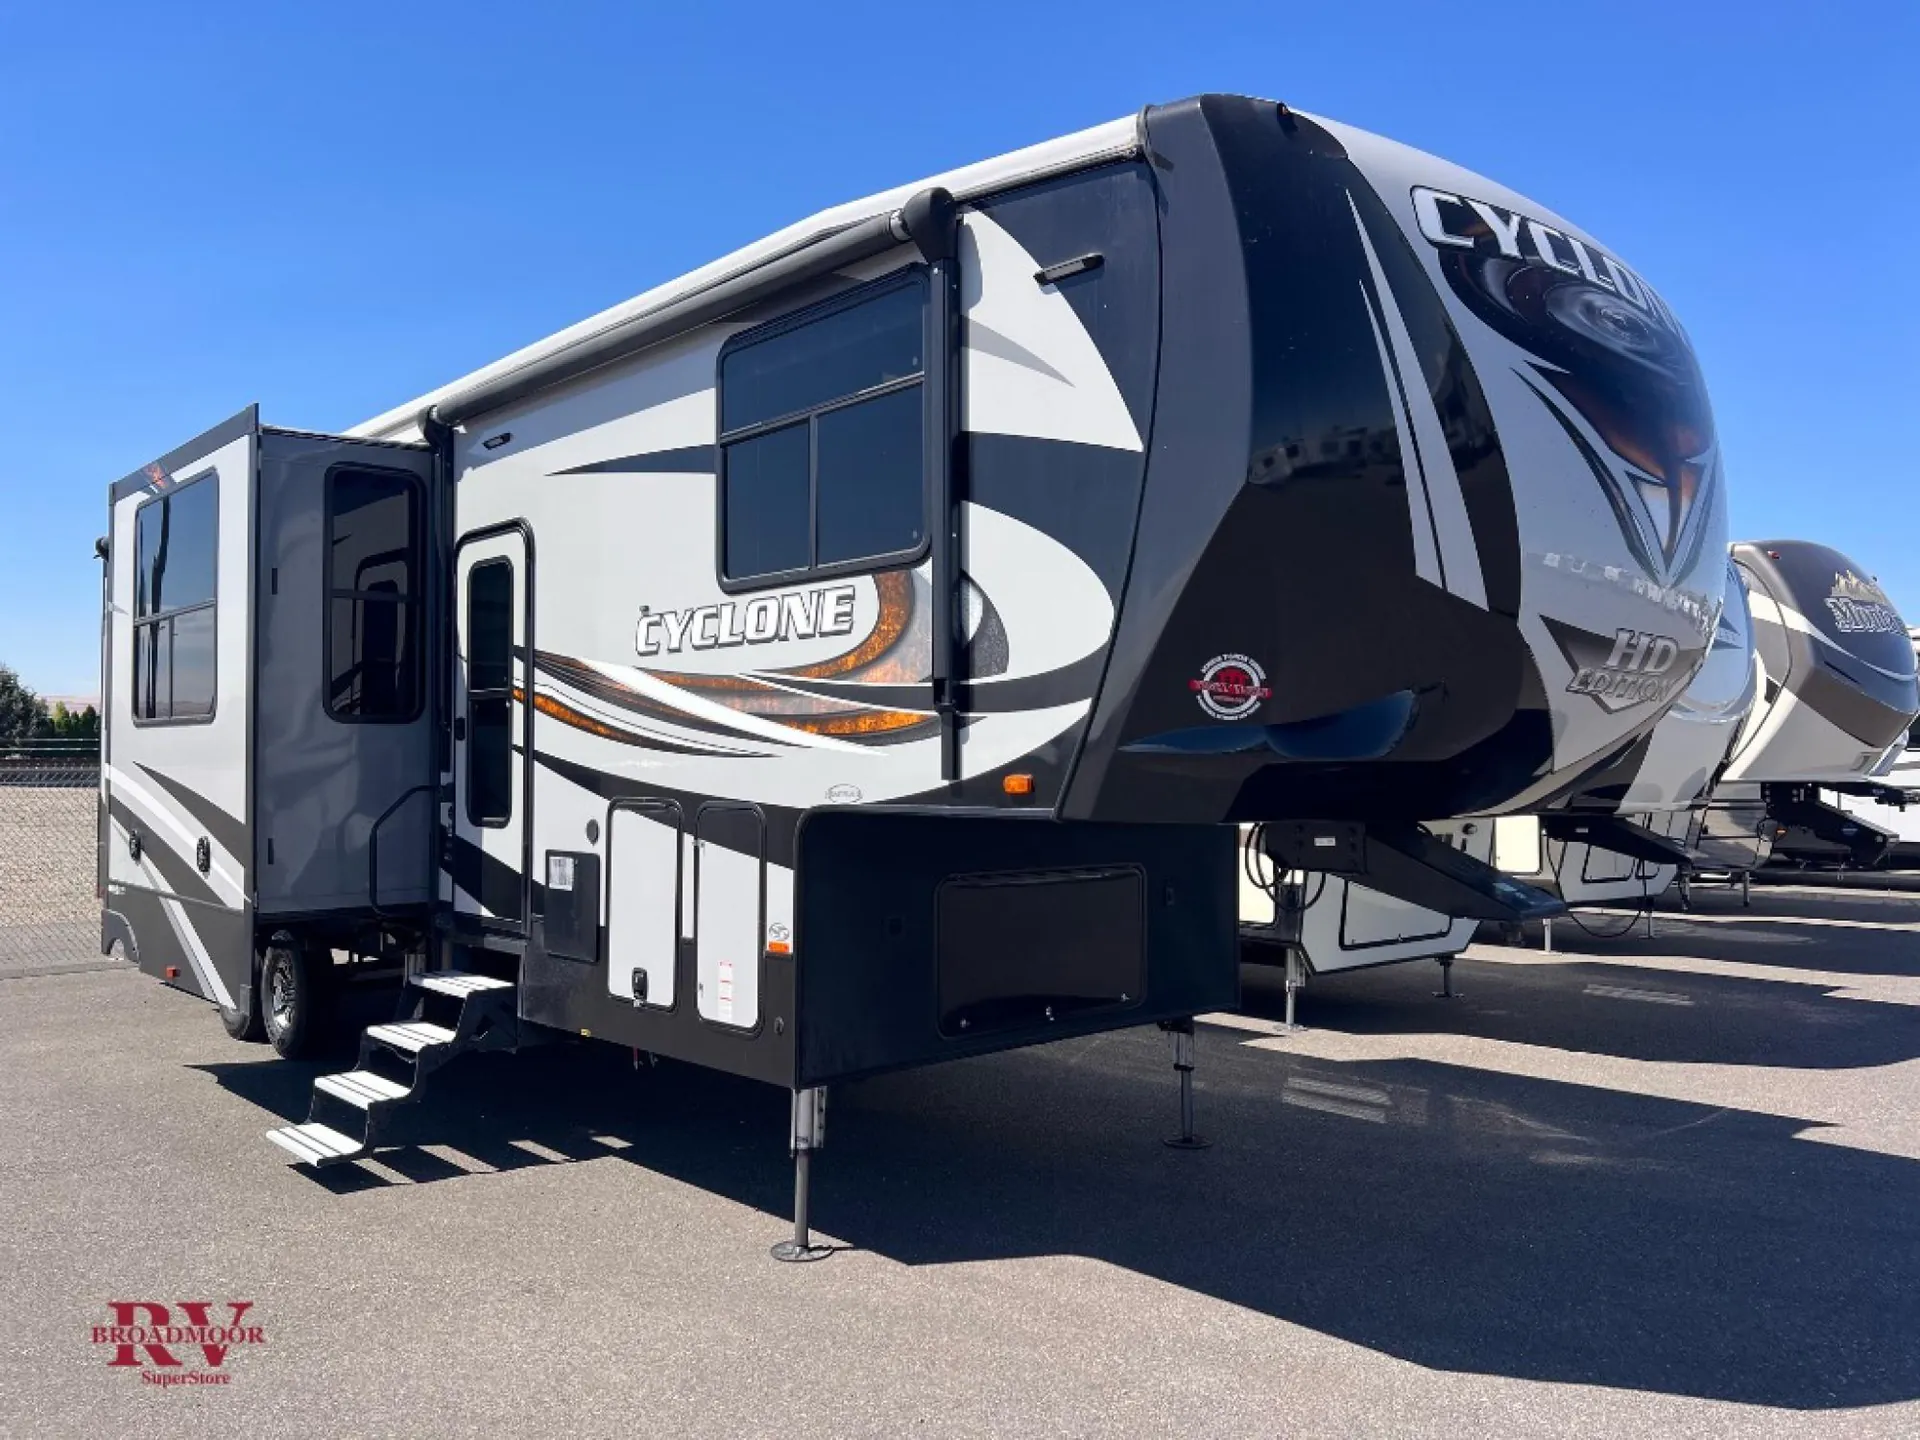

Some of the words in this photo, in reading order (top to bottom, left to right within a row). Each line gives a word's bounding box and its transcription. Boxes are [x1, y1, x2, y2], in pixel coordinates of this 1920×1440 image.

[636, 585, 855, 656] CYCLONE
[1603, 628, 1679, 676] HD
[1566, 668, 1673, 702] EDITION
